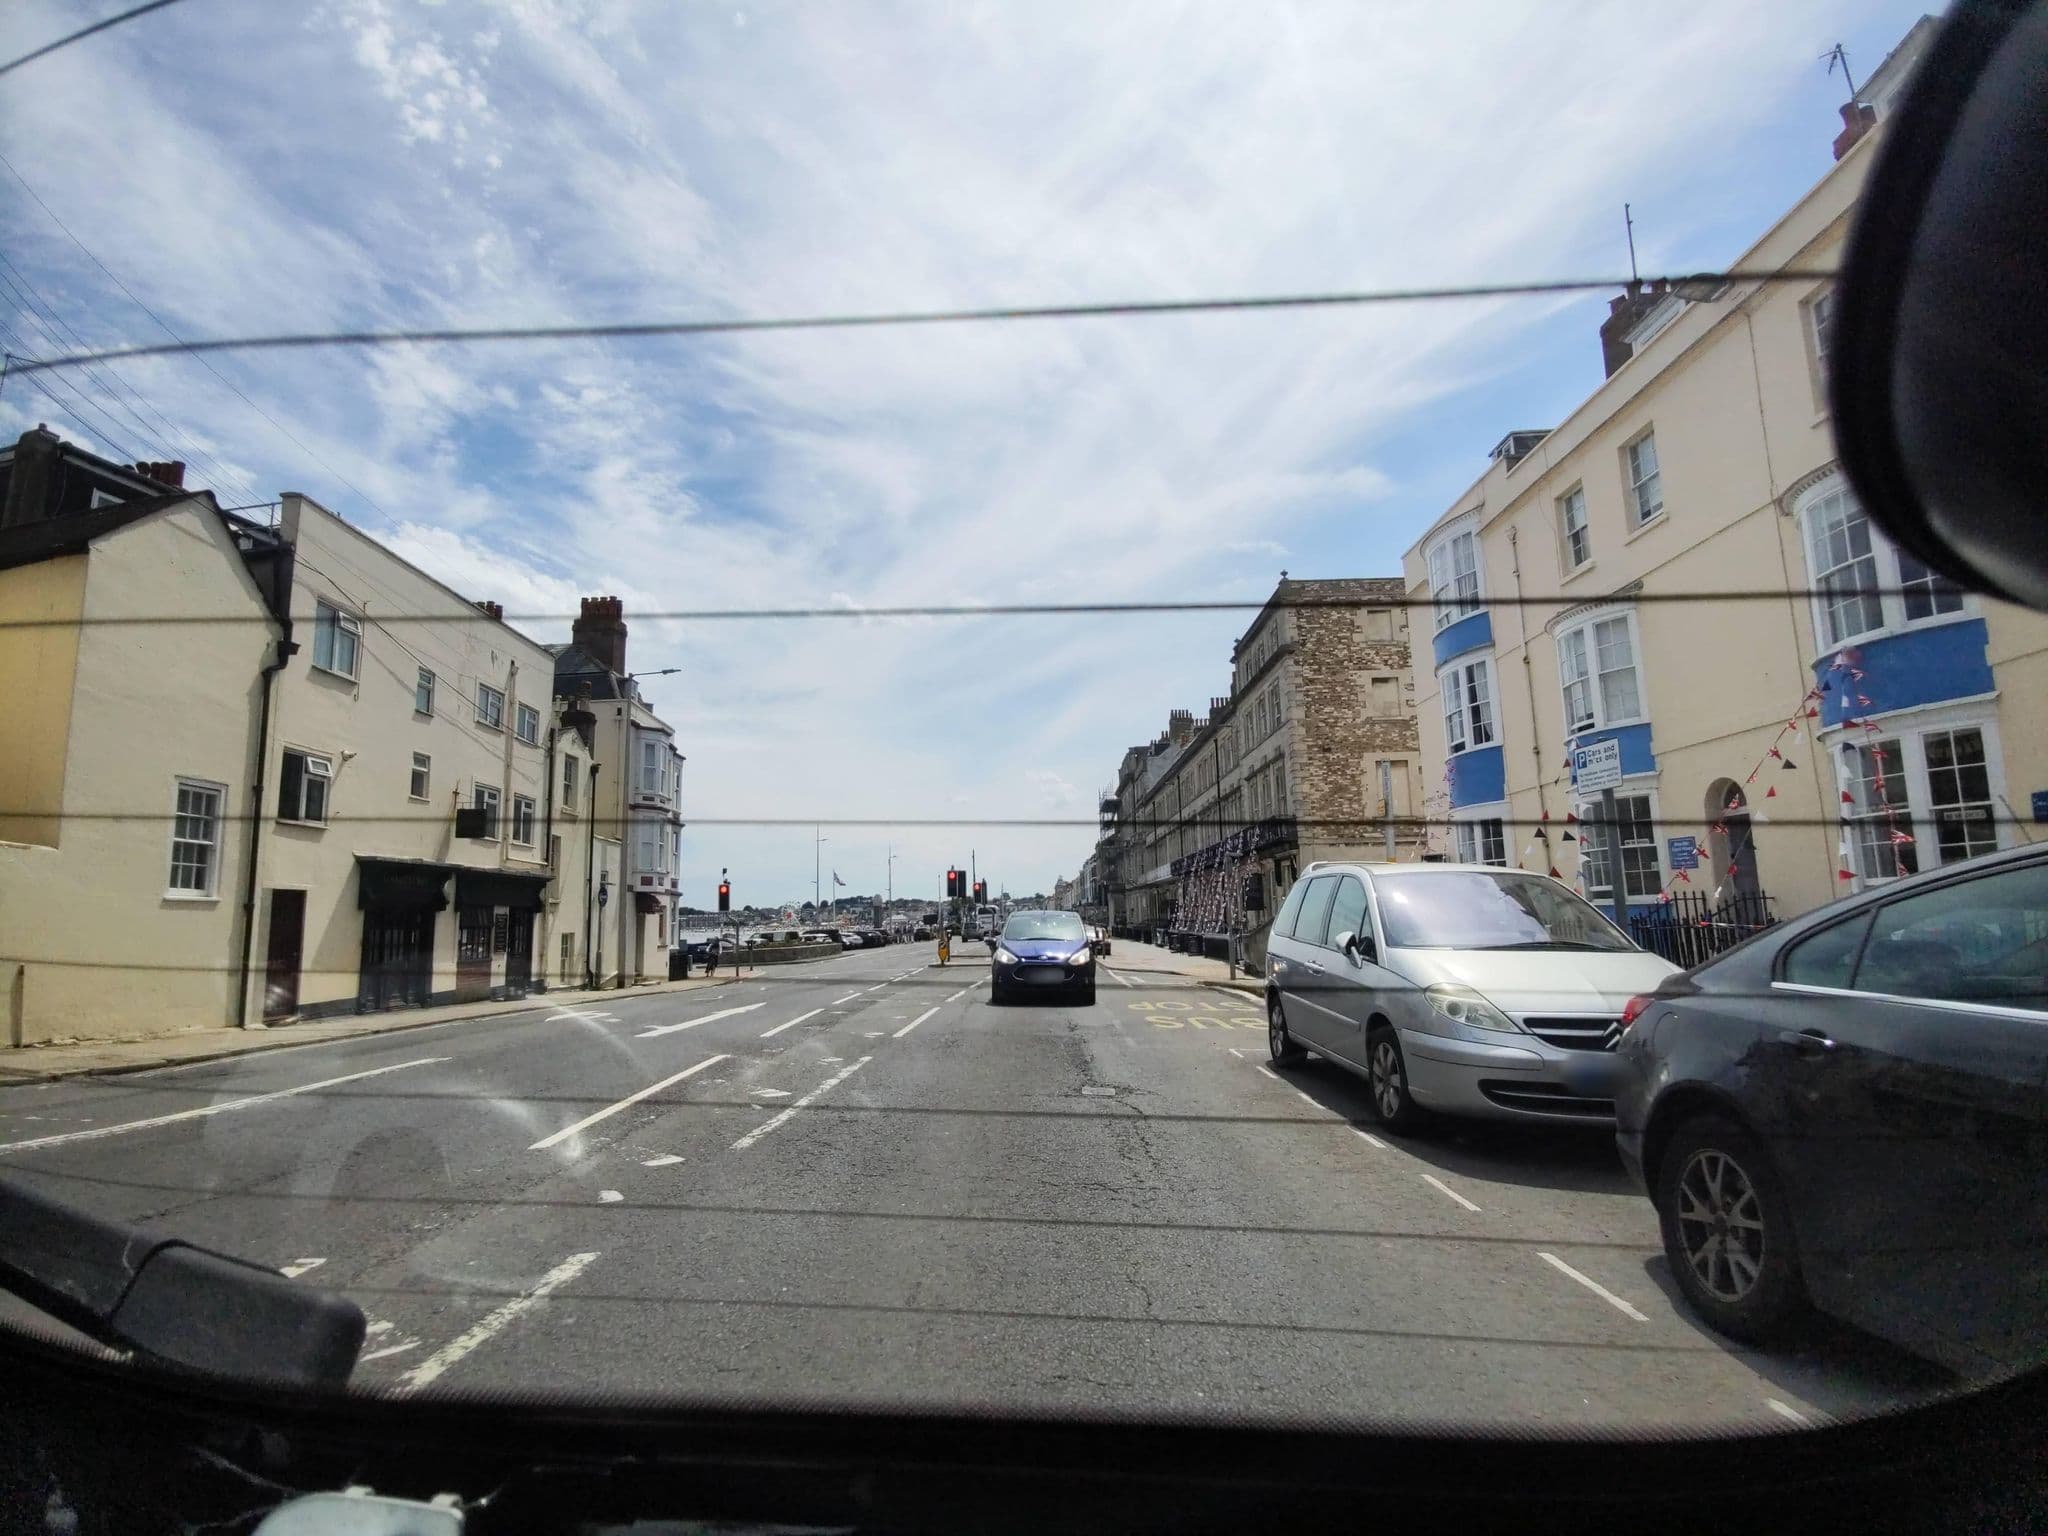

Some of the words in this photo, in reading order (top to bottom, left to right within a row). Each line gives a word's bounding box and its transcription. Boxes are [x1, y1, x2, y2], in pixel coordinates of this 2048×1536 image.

[1587, 749, 1602, 758] Cars
[1603, 744, 1615, 753] and
[1604, 751, 1618, 761] only
[1578, 752, 1586, 768] P
